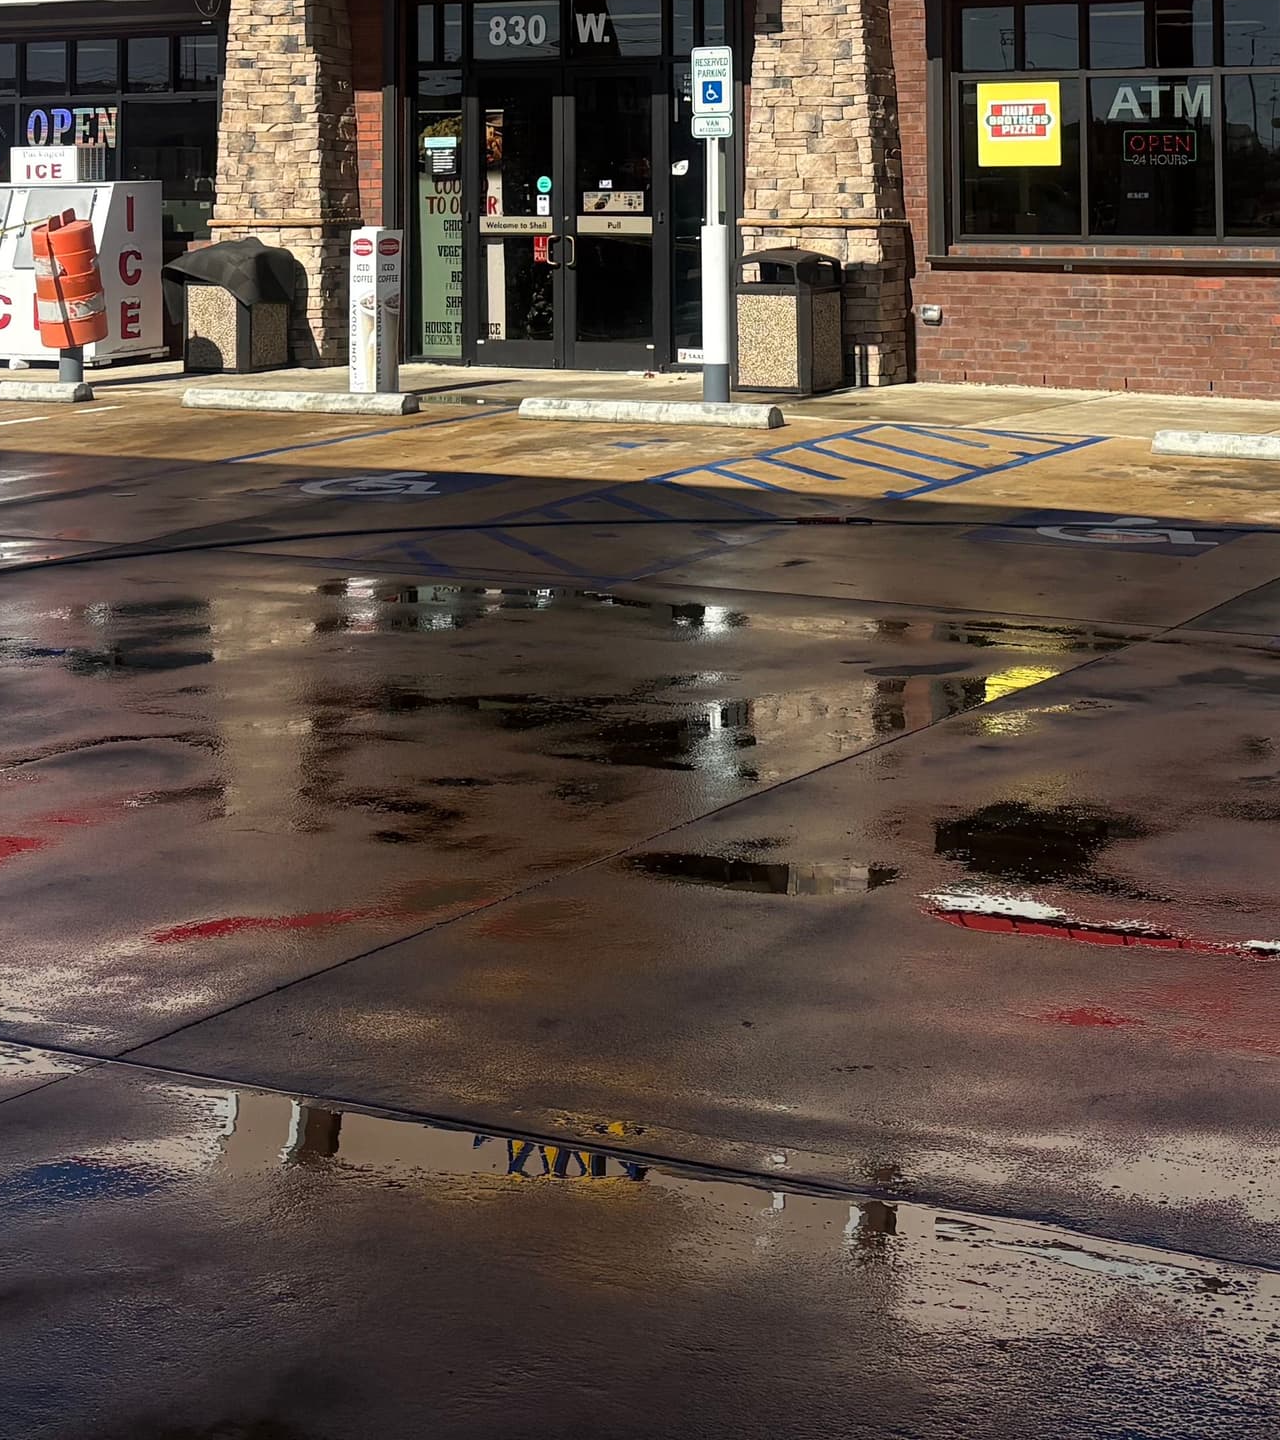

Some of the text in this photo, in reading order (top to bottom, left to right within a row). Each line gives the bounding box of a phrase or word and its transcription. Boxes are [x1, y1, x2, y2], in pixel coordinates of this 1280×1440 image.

[489, 13, 610, 45] 830 W.
[695, 57, 729, 67] RESERVED
[697, 68, 727, 78] PARKING
[1107, 85, 1212, 119] ATM
[1002, 105, 1034, 116] HUNT
[988, 115, 1049, 126] BROTHERS
[26, 107, 118, 149] OPEN
[1002, 125, 1036, 135] PIZZA
[1130, 135, 1191, 152] OPEN
[23, 149, 65, 160] Packaged
[1132, 154, 1188, 165] 24 HOURS
[26, 163, 63, 179] ICE
[425, 196, 446, 214] TO
[486, 221, 518, 229] Welcome
[530, 221, 547, 229] Shell
[607, 221, 621, 229] Pull
[119, 195, 143, 339] ICE
[382, 263, 396, 271] ICED
[378, 274, 399, 283] COFFEE
[425, 322, 452, 334] HOUSE
